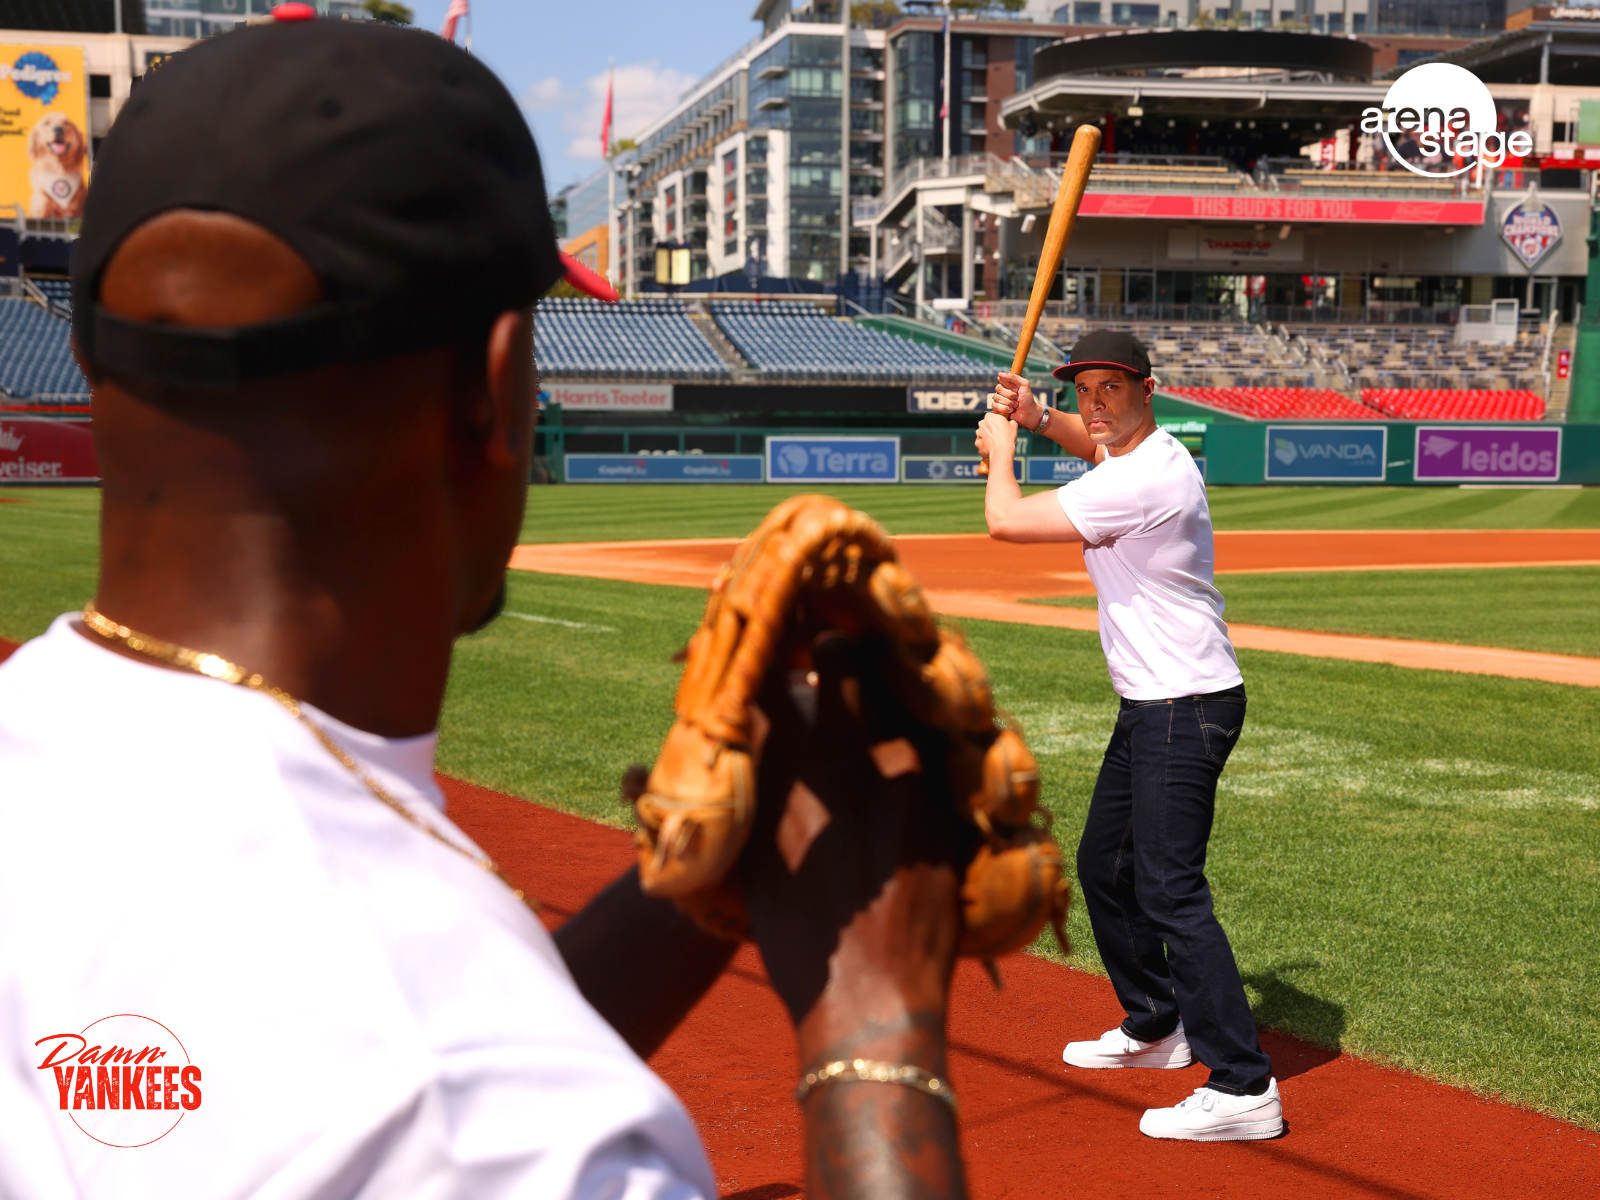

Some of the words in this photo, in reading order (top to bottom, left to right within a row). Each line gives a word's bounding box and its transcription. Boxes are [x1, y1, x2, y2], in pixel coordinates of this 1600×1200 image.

[1191, 197, 1229, 217] THIS
[1232, 198, 1282, 218] BUD'S
[1284, 199, 1316, 218] FOR
[1319, 200, 1357, 220] YOU.
[554, 388, 609, 405] Harris
[611, 388, 669, 405] Teeter
[810, 447, 889, 473] Terra
[1298, 443, 1377, 460] VANDA
[1461, 441, 1554, 473] leidos
[1053, 460, 1088, 474] MGM
